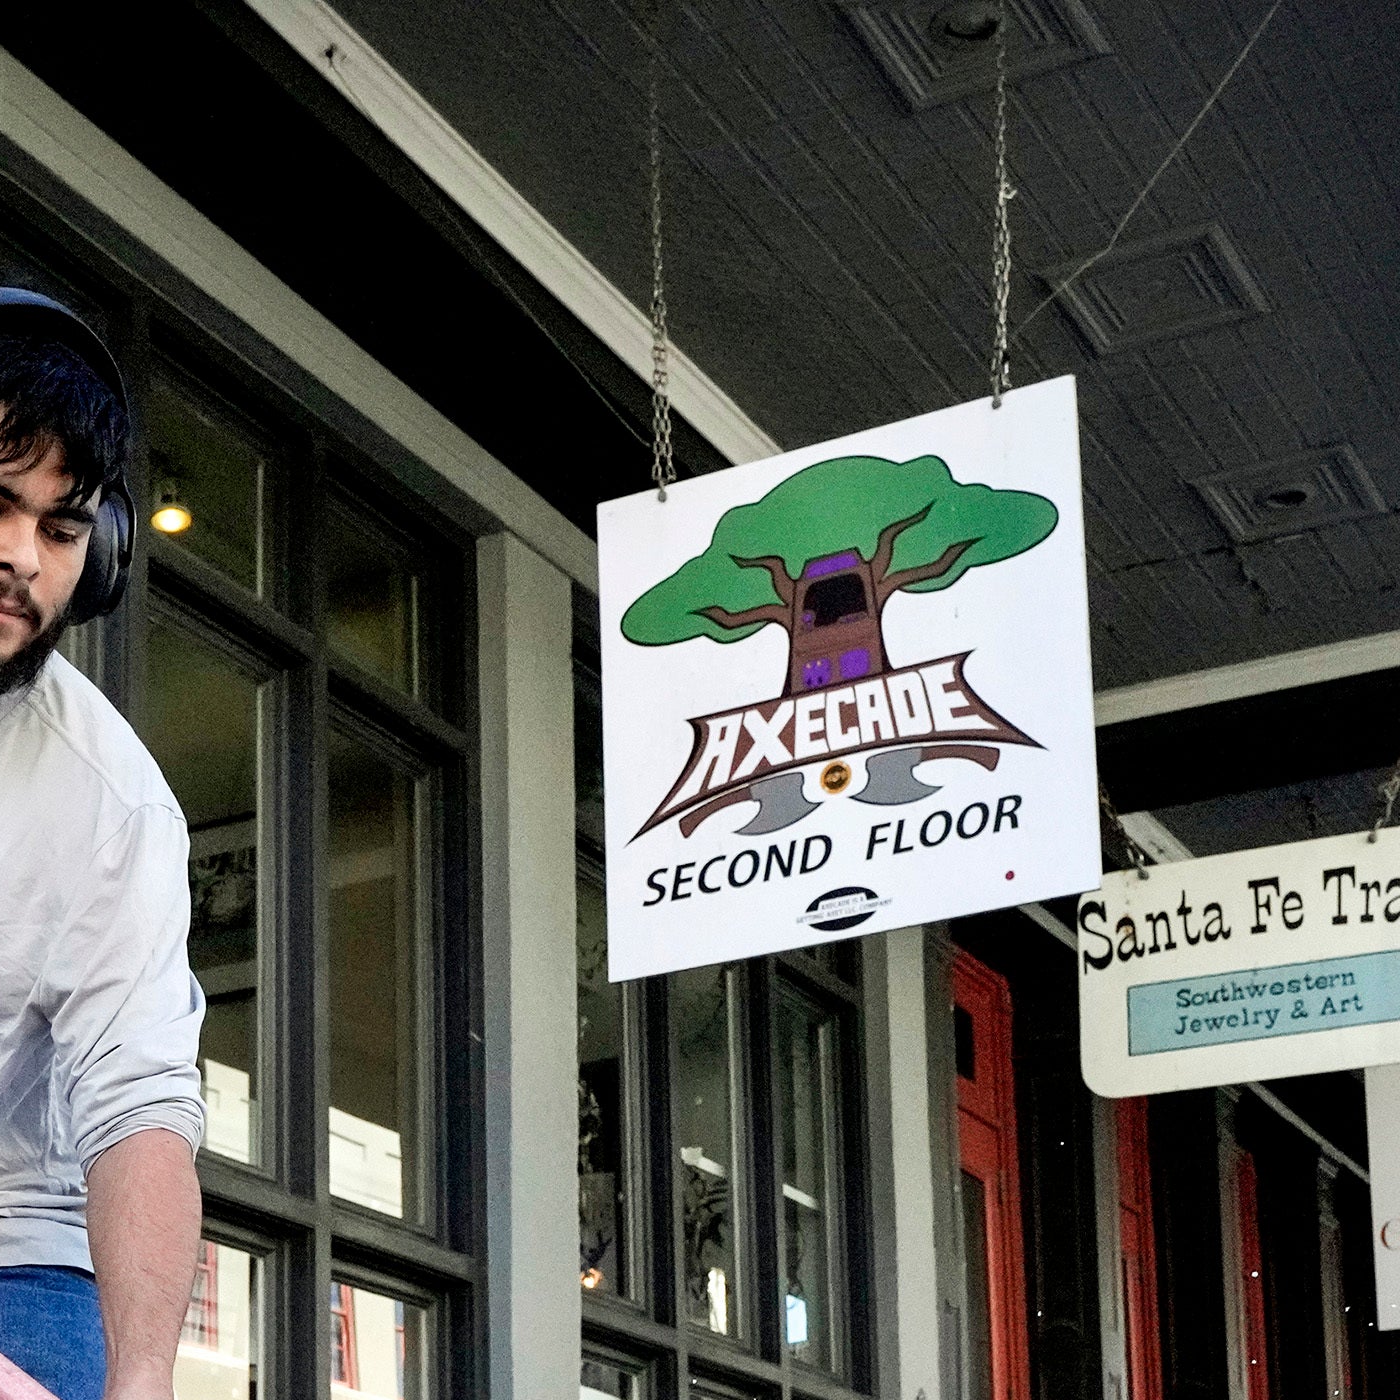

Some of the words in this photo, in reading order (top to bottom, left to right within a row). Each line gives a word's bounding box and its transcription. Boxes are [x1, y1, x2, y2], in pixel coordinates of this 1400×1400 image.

[664, 660, 1000, 811] AXECADE
[642, 833, 833, 907] SECOND
[865, 794, 1023, 862] FLOOR
[1078, 890, 1233, 976] Santa
[1247, 876, 1305, 936] Fe
[1173, 1002, 1281, 1037] Jewelry
[1290, 999, 1310, 1021] &
[1321, 993, 1365, 1018] Art
[1175, 968, 1357, 1009] Southwestern
